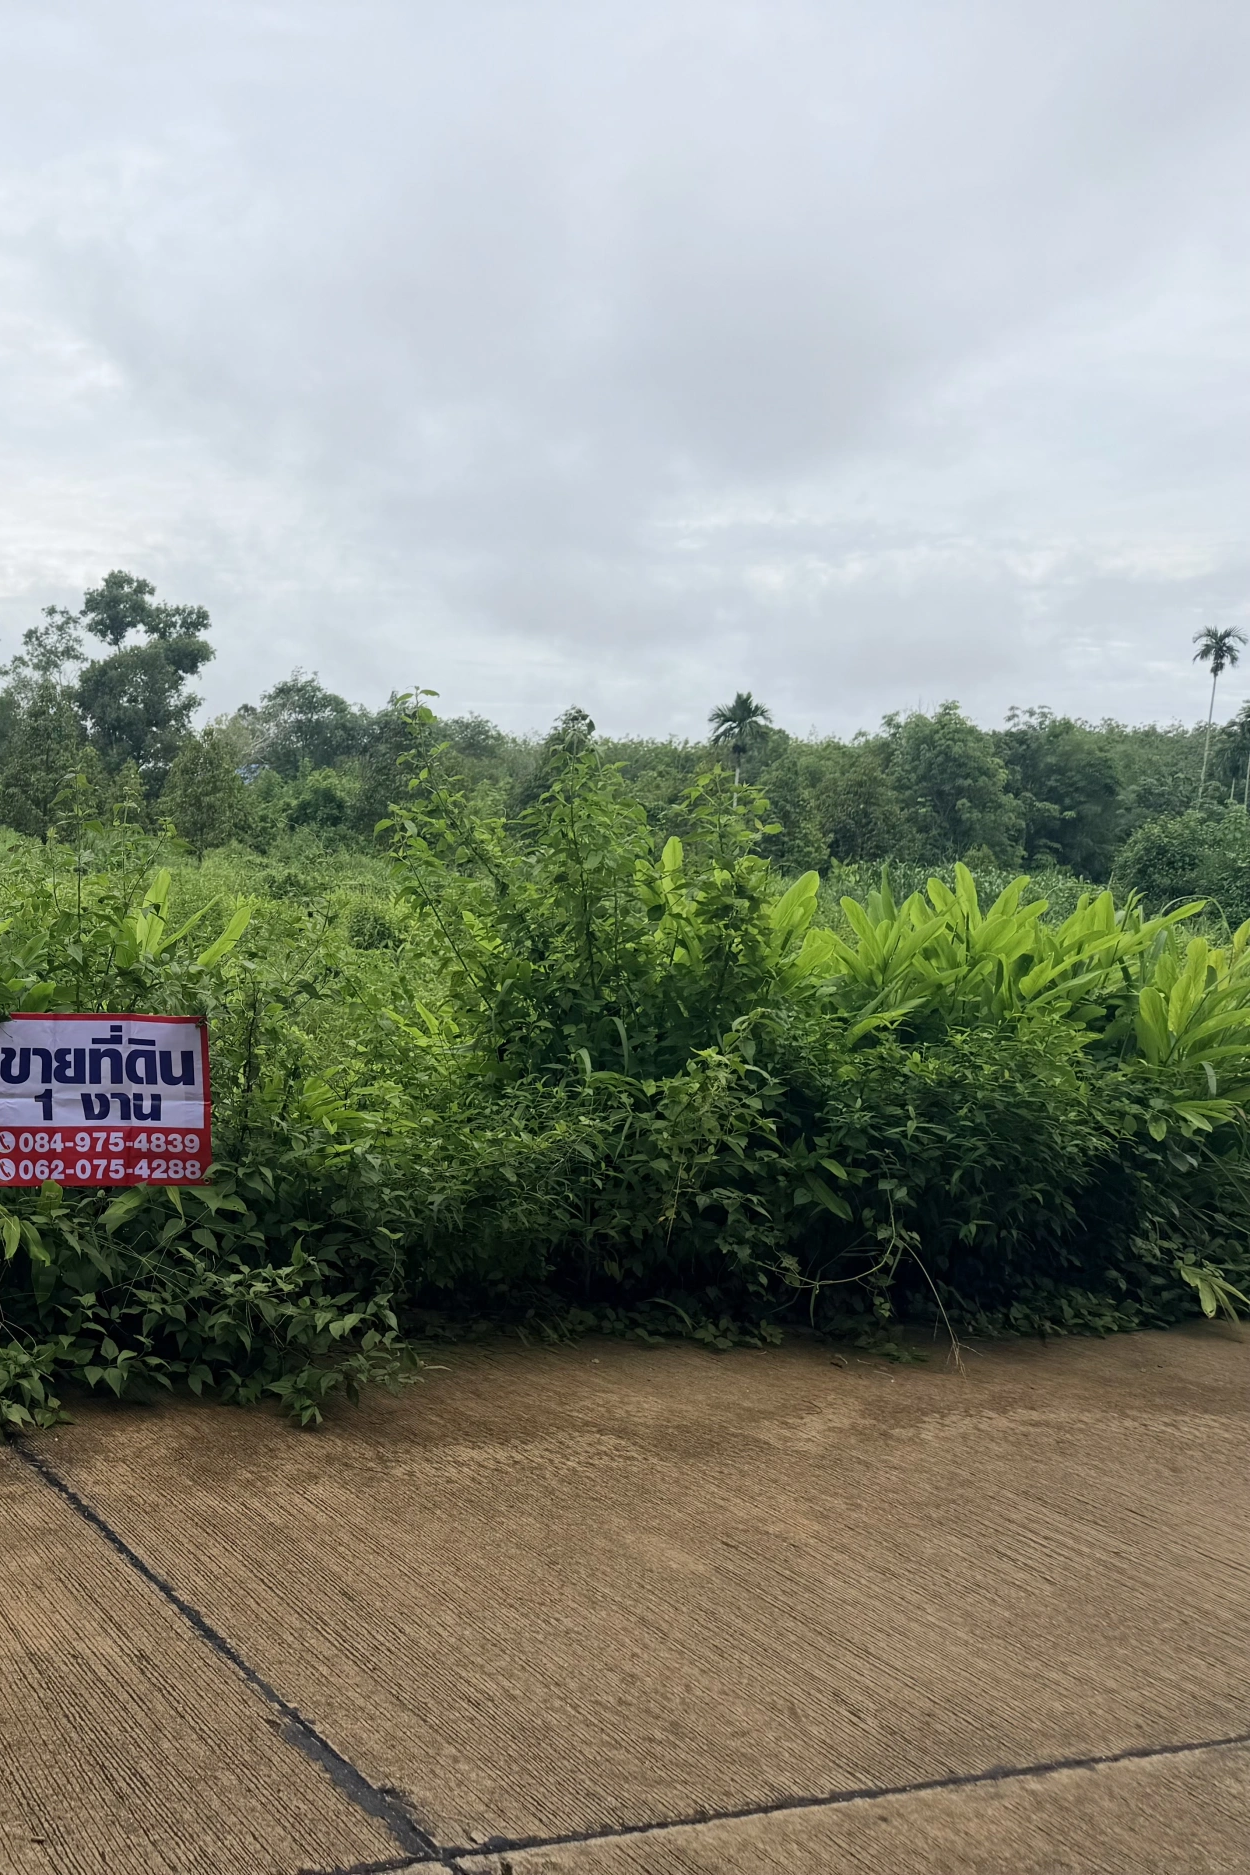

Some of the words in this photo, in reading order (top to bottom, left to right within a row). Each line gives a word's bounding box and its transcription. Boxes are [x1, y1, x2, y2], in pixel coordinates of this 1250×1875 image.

[0, 1024, 195, 1086] ขายที่ดิน
[34, 1088, 53, 1121] 1
[80, 1092, 162, 1121] งาน
[18, 1132, 201, 1153] 084-975-4839
[18, 1158, 202, 1180] 062-075-4288
